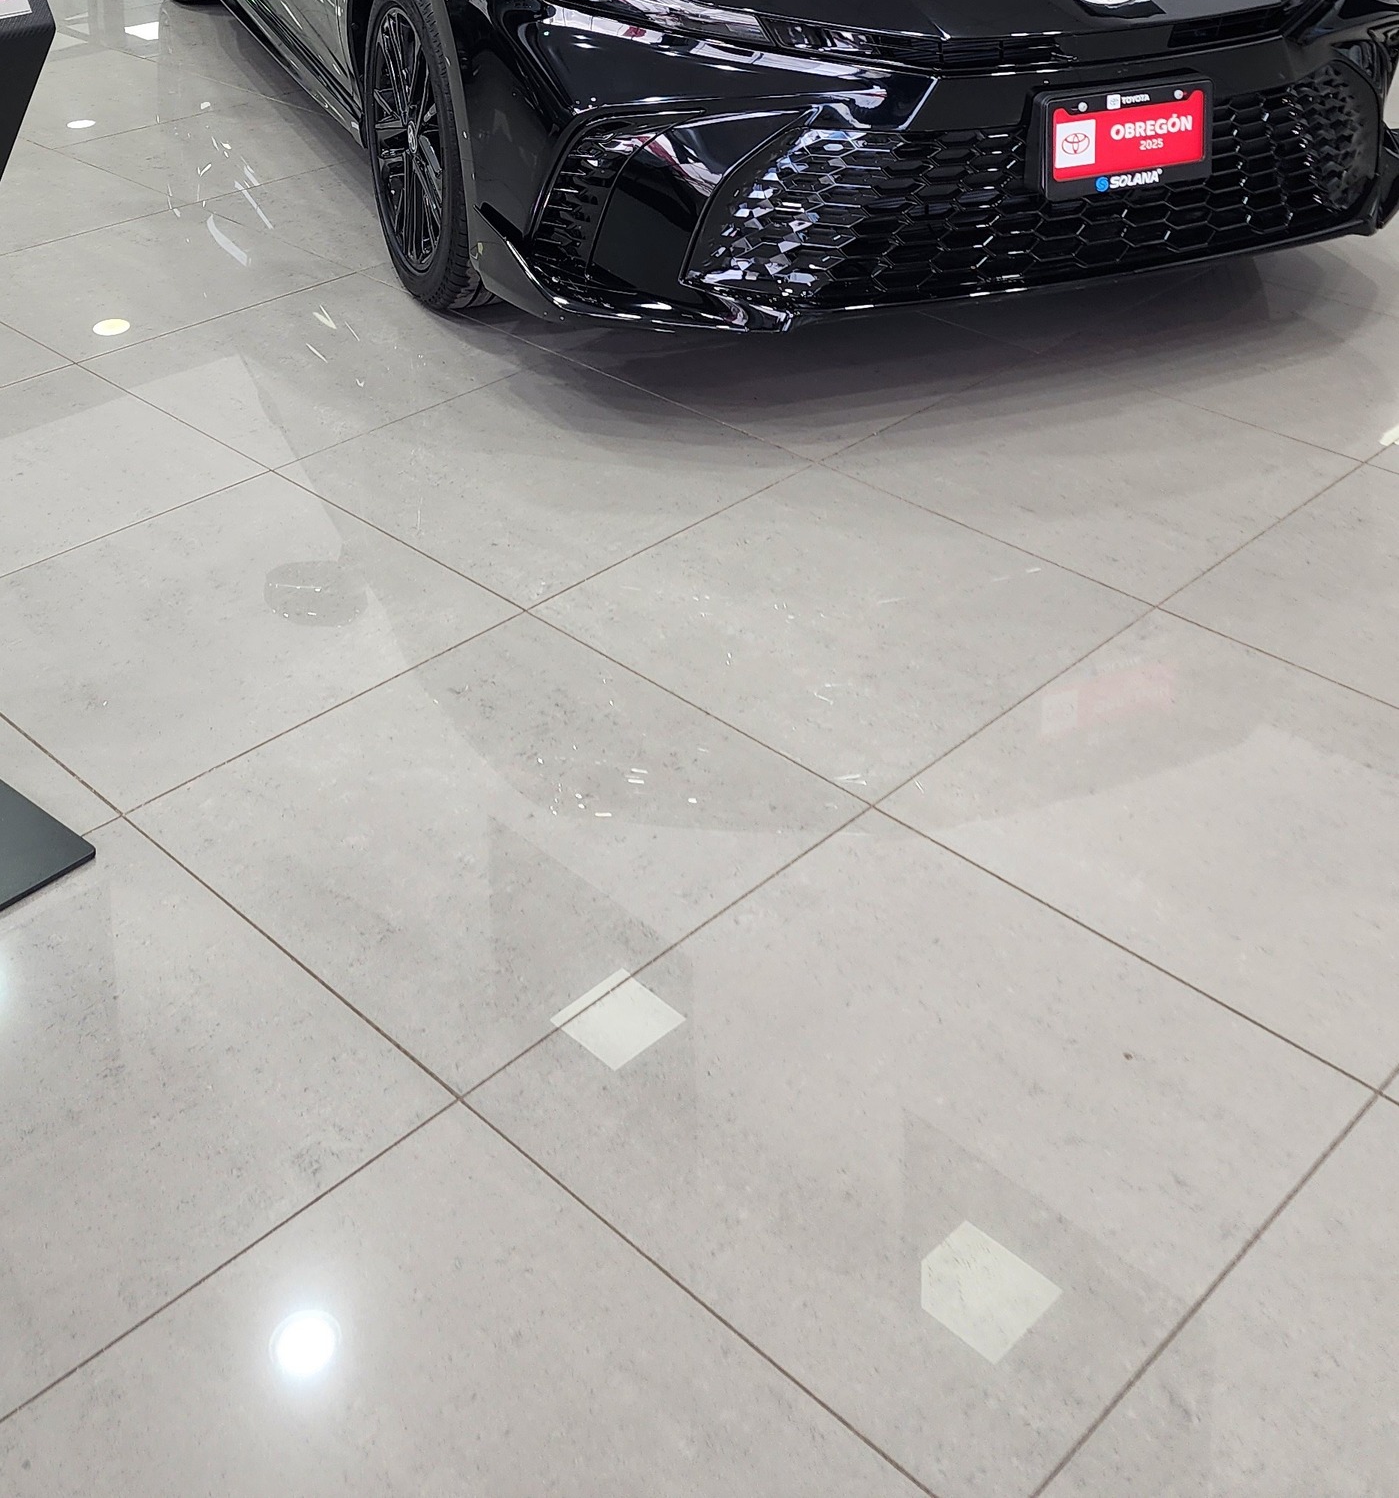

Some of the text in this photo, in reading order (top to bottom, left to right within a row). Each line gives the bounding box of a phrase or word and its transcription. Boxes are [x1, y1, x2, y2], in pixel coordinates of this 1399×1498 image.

[1121, 94, 1150, 104] TOYOTA
[1110, 113, 1193, 140] OBREGÓN
[1139, 138, 1164, 150] 2025
[1109, 171, 1161, 190] SOLANA
